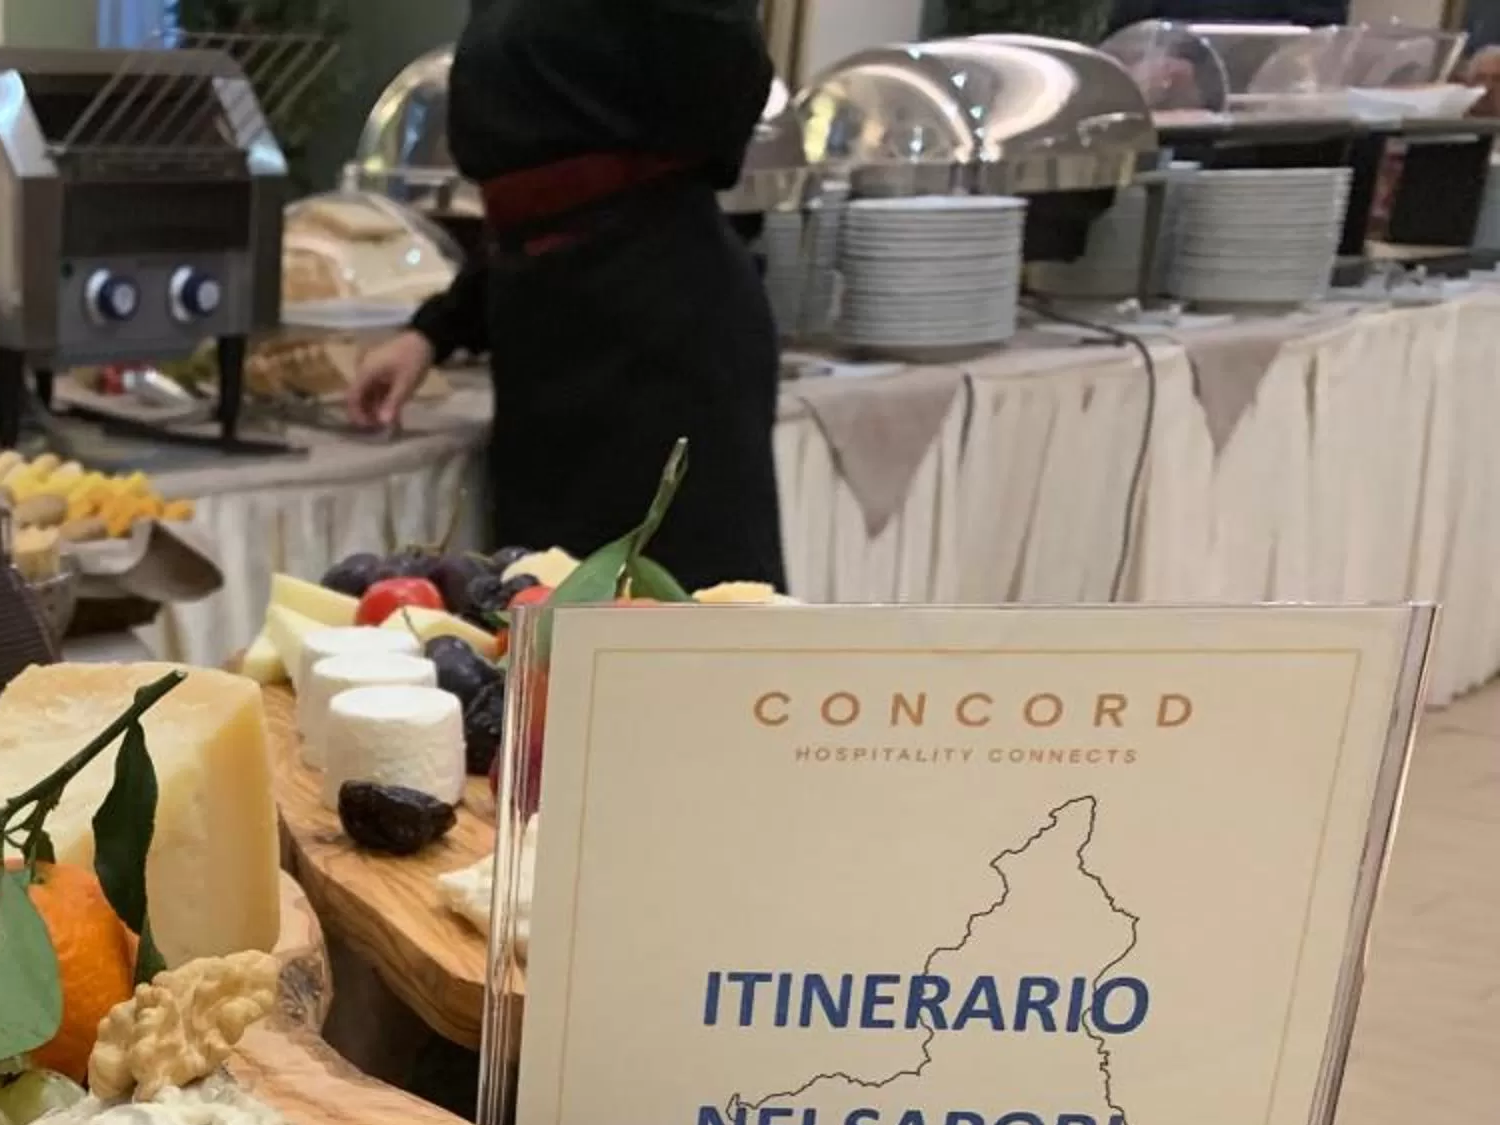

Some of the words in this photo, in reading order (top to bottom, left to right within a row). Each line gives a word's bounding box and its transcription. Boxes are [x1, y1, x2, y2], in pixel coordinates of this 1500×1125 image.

[752, 691, 1194, 728] CONCORD
[795, 746, 974, 763] HOSPITALITY
[988, 747, 1139, 764] CONNECTS
[702, 971, 1149, 1034] ITINERARIO
